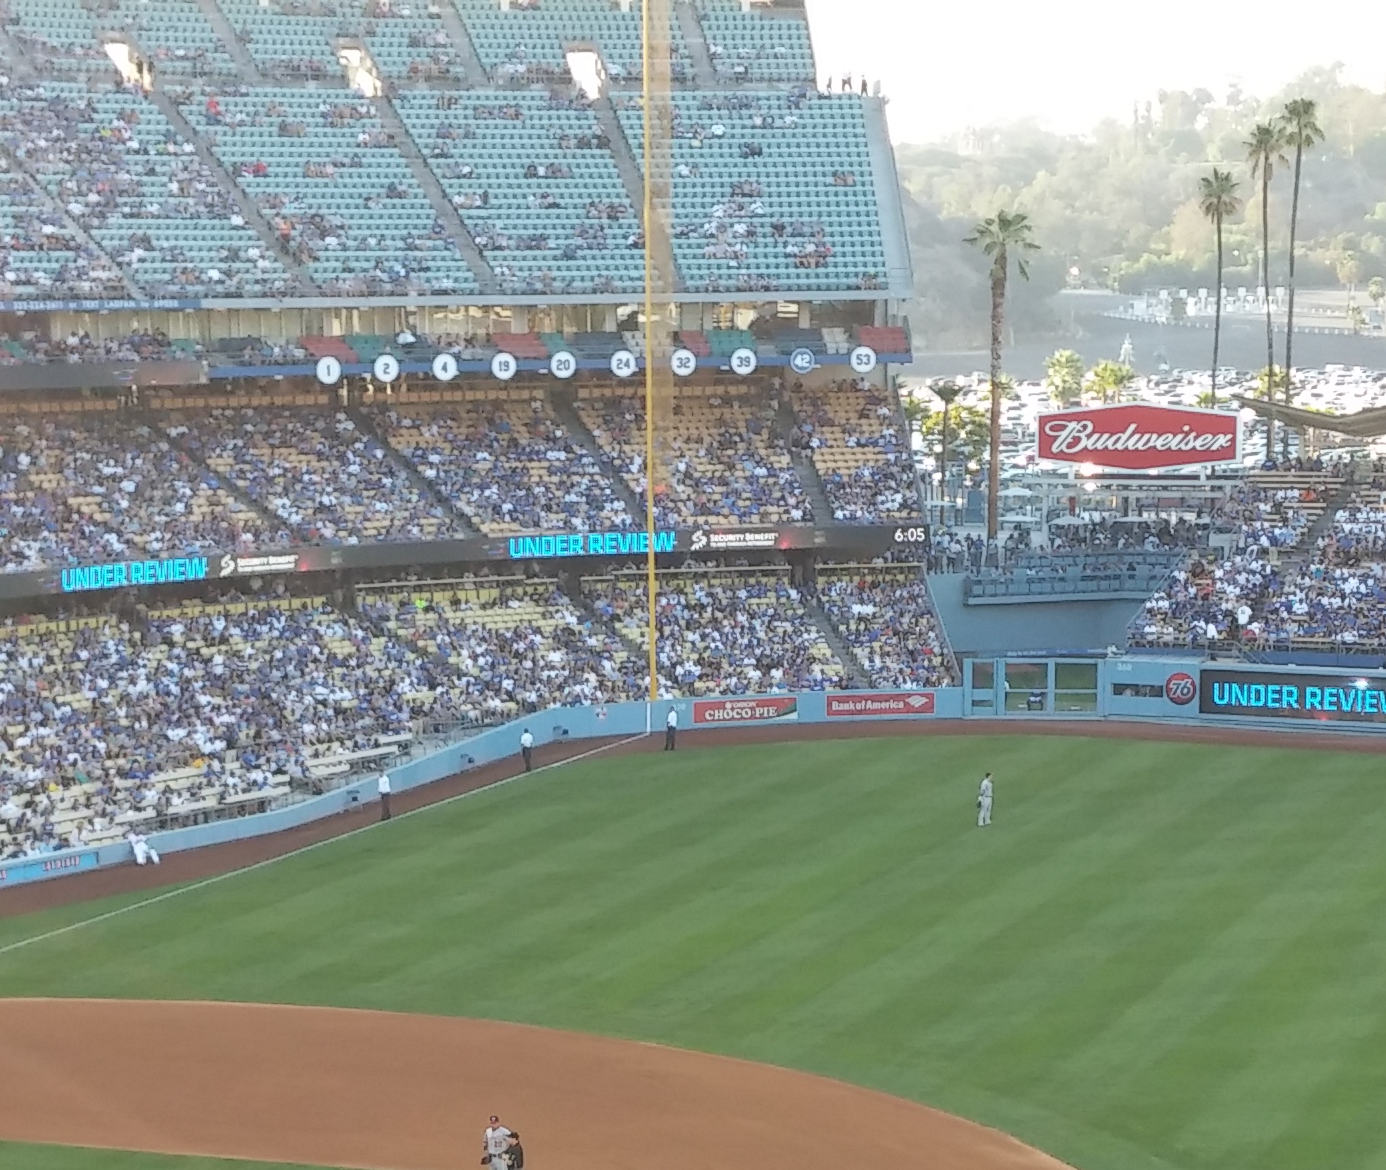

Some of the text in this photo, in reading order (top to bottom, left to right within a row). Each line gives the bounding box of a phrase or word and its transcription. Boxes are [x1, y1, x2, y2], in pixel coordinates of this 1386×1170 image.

[498, 360, 510, 372] 19
[556, 359, 571, 371] 20
[616, 358, 631, 370] 24
[676, 357, 691, 369] 32
[736, 356, 751, 368] 39
[794, 354, 811, 366] 42
[855, 354, 871, 366] 53
[1044, 420, 1234, 454] Budweiser
[894, 528, 925, 542] 6:05
[507, 531, 676, 559] UNDER REVIEW
[61, 557, 208, 592] UNDER REVIEW
[1169, 680, 1193, 698] 76
[1213, 682, 1299, 709] UNDER
[832, 699, 904, 711] Bank of America
[705, 706, 778, 720] CHOCO PIE
